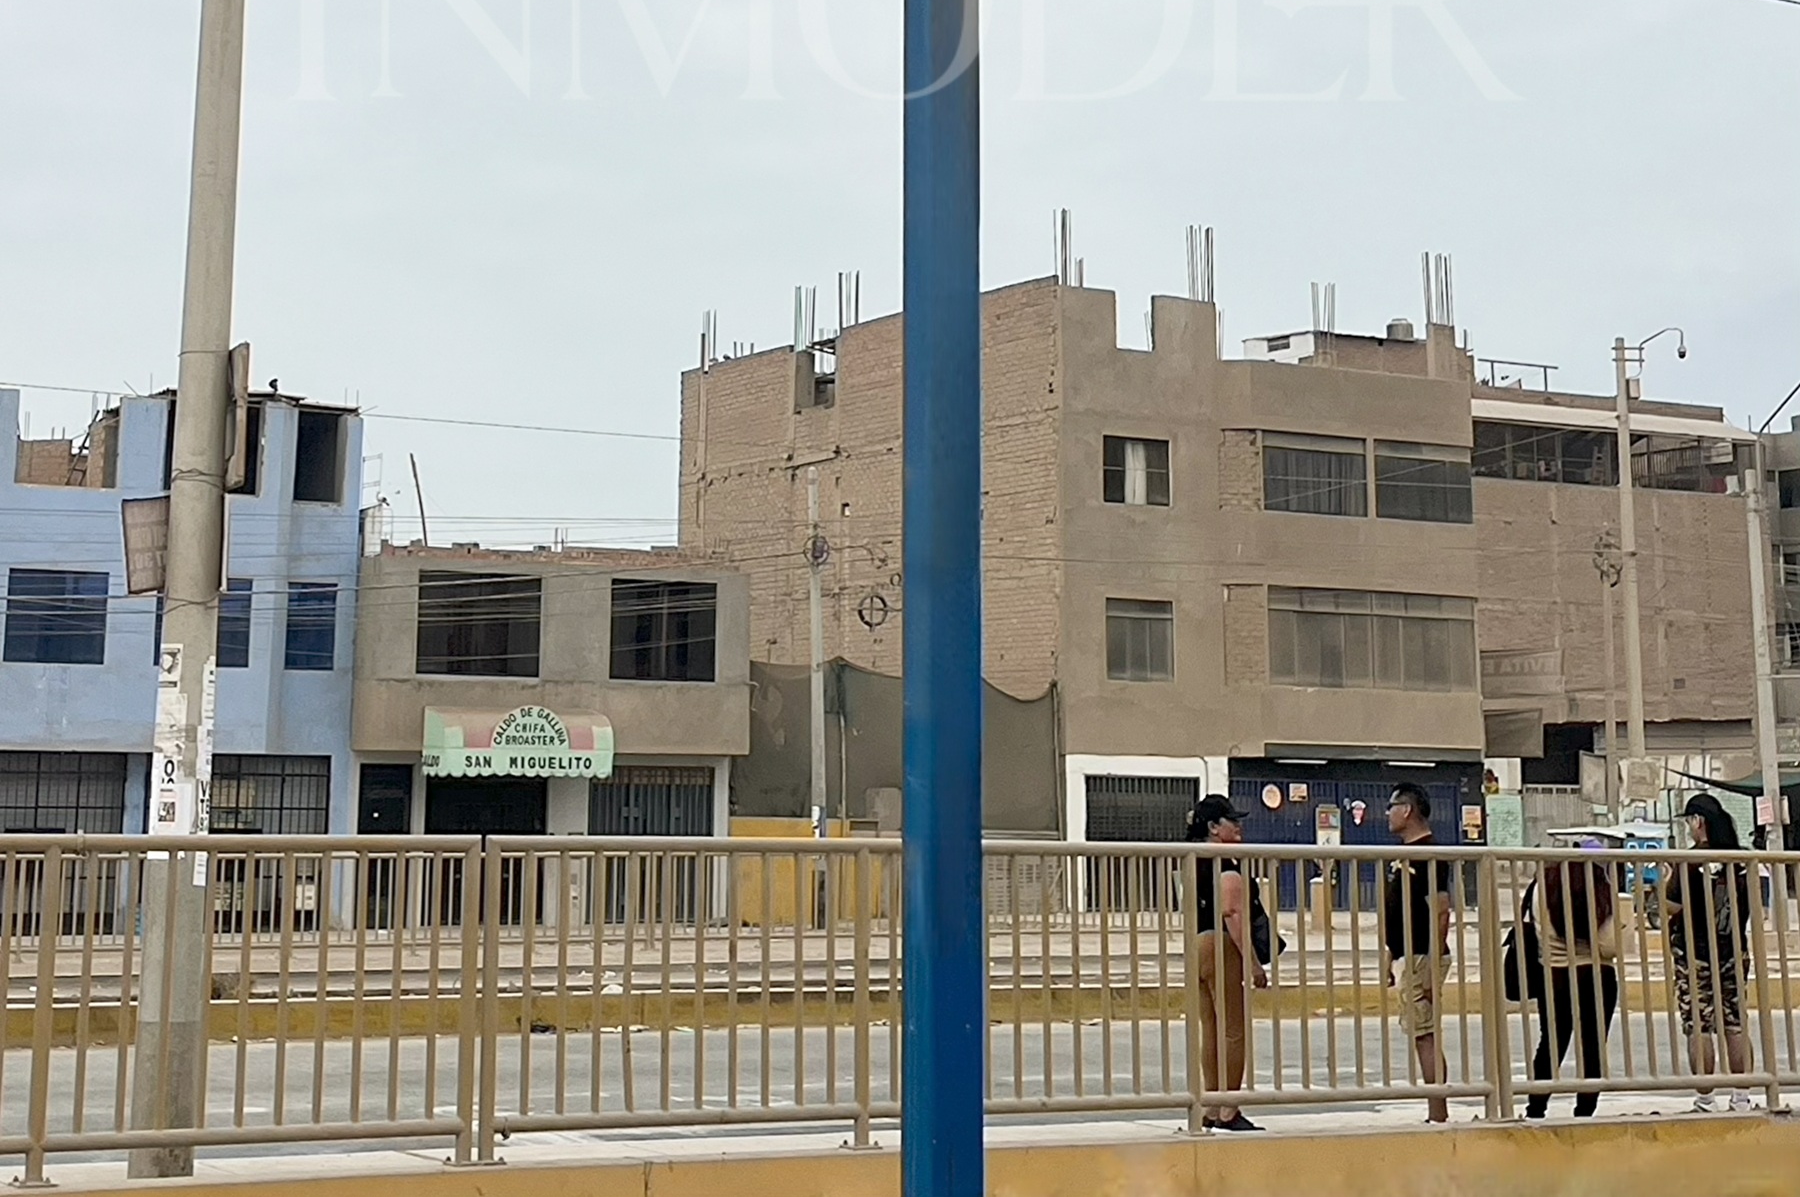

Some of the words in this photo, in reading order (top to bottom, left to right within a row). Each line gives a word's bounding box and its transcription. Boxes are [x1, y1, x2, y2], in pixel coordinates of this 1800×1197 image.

[493, 713, 517, 745] CALDO
[520, 707, 534, 719] DE
[537, 708, 567, 746] GALLINA
[514, 723, 546, 734] CHIFA
[505, 735, 555, 745] BROASTER
[465, 755, 492, 769] SAN
[509, 756, 592, 770] MIGUELITO
